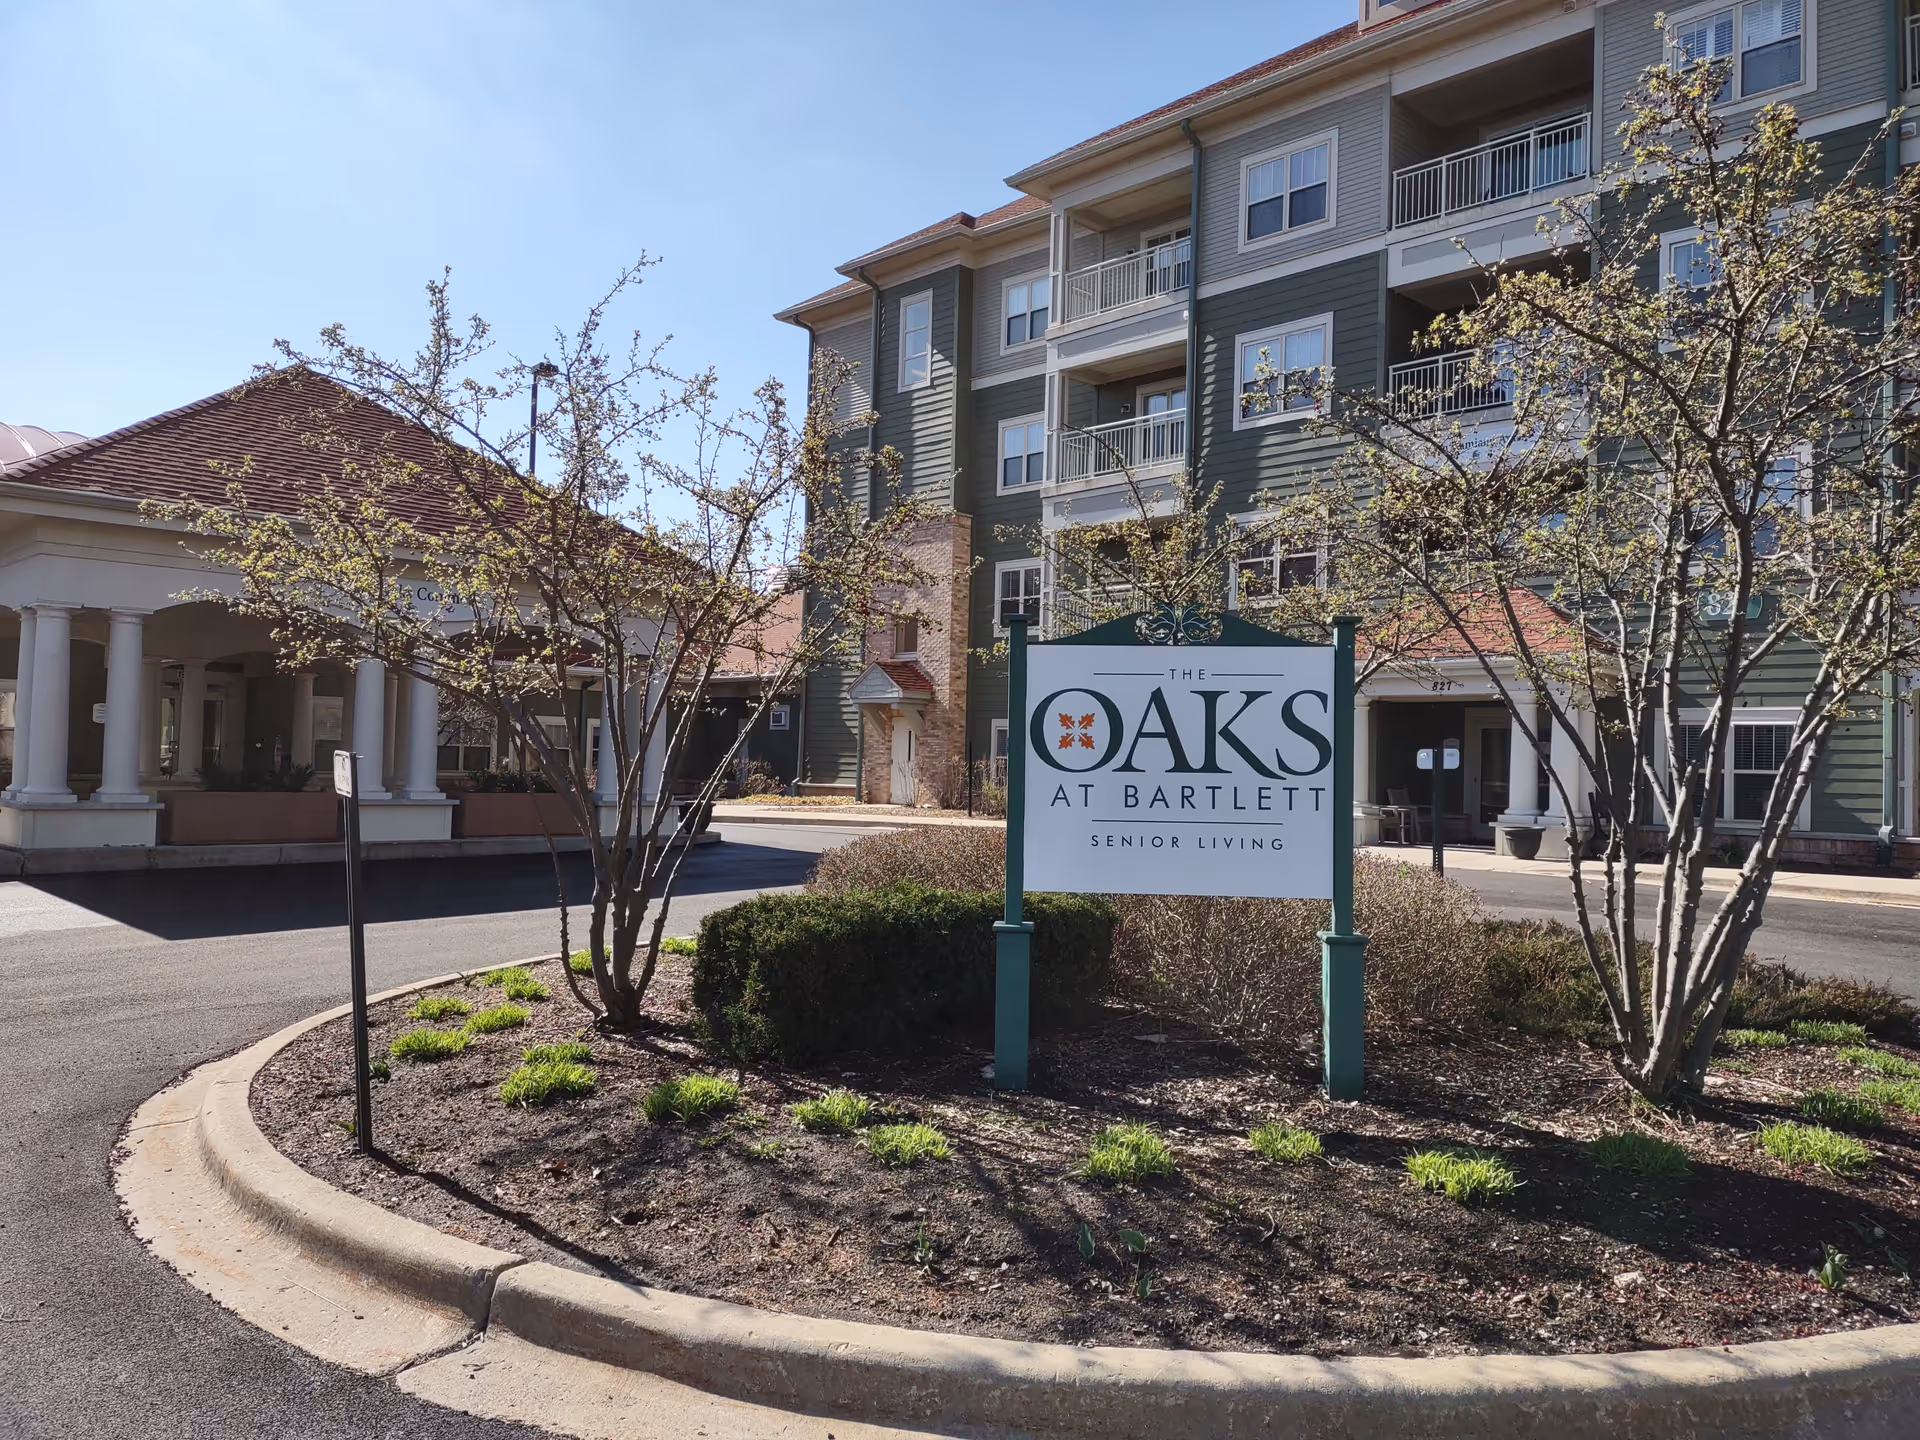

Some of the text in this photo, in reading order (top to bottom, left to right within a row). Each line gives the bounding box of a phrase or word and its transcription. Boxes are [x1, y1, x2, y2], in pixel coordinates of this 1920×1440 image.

[1168, 668, 1207, 681] THE
[1431, 681, 1452, 691] 827
[1029, 685, 1333, 780] OAKS
[1050, 783, 1326, 812] AT BARTLETT
[1091, 834, 1285, 851] SENIOR LIVING
